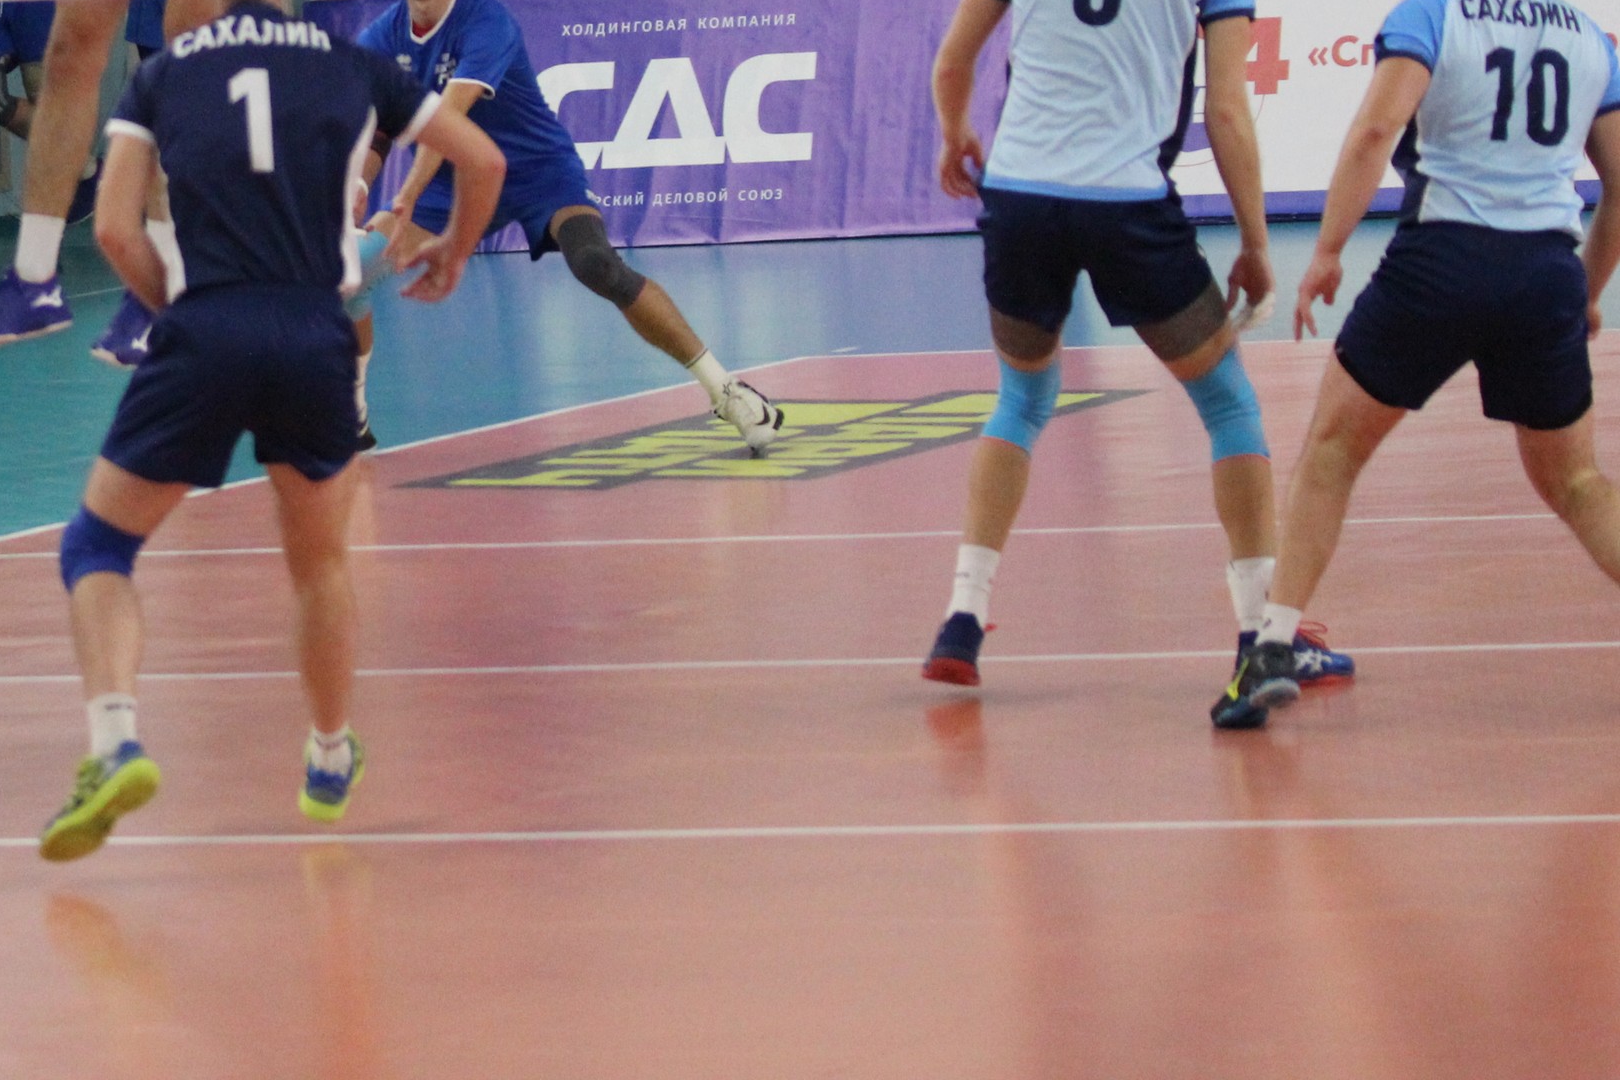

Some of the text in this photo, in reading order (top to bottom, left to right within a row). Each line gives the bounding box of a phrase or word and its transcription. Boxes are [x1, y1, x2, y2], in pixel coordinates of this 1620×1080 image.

[561, 13, 797, 37] ХОЛДИНГОВАЯ КОМПАНИЯ
[227, 67, 275, 174] 1
[1485, 46, 1570, 147] 10
[652, 189, 728, 208] ДЕЛОВОЙ
[738, 188, 784, 202] СОЮЗ
